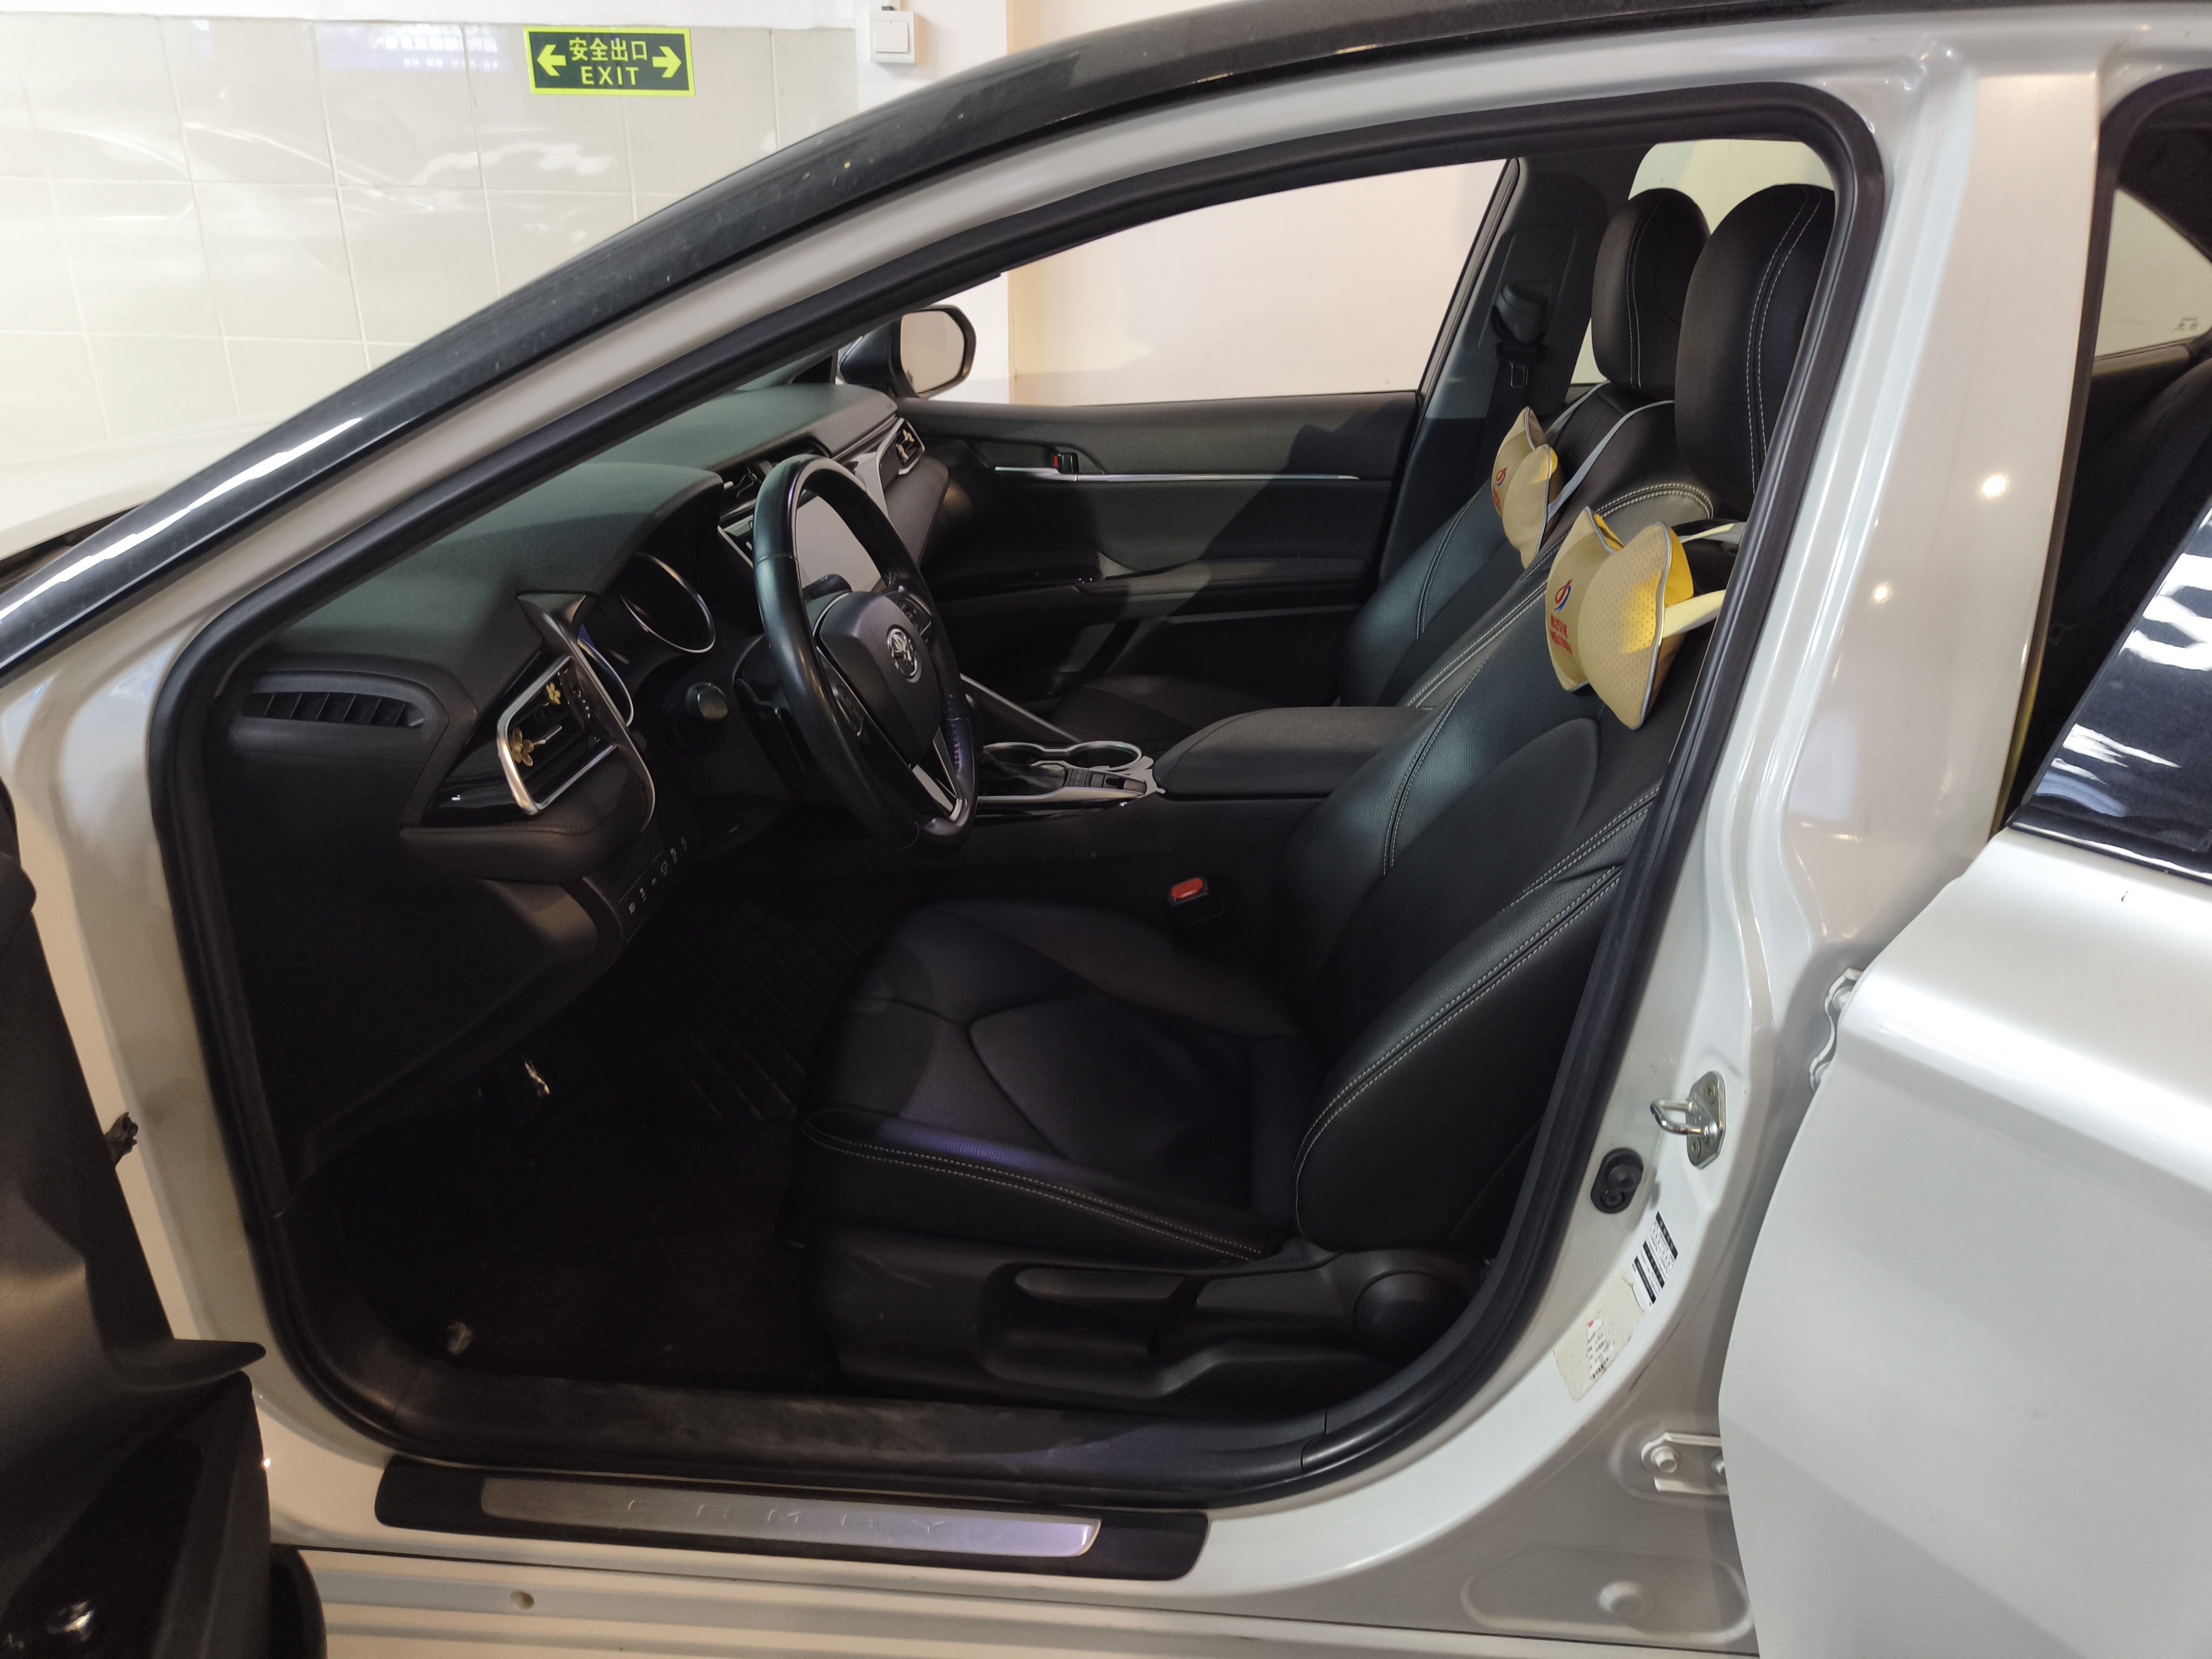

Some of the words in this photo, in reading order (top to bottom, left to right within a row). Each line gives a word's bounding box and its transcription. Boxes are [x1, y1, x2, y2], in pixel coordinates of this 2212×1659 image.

[569, 37, 648, 62] 安全出口
[581, 66, 639, 85] EXIT
